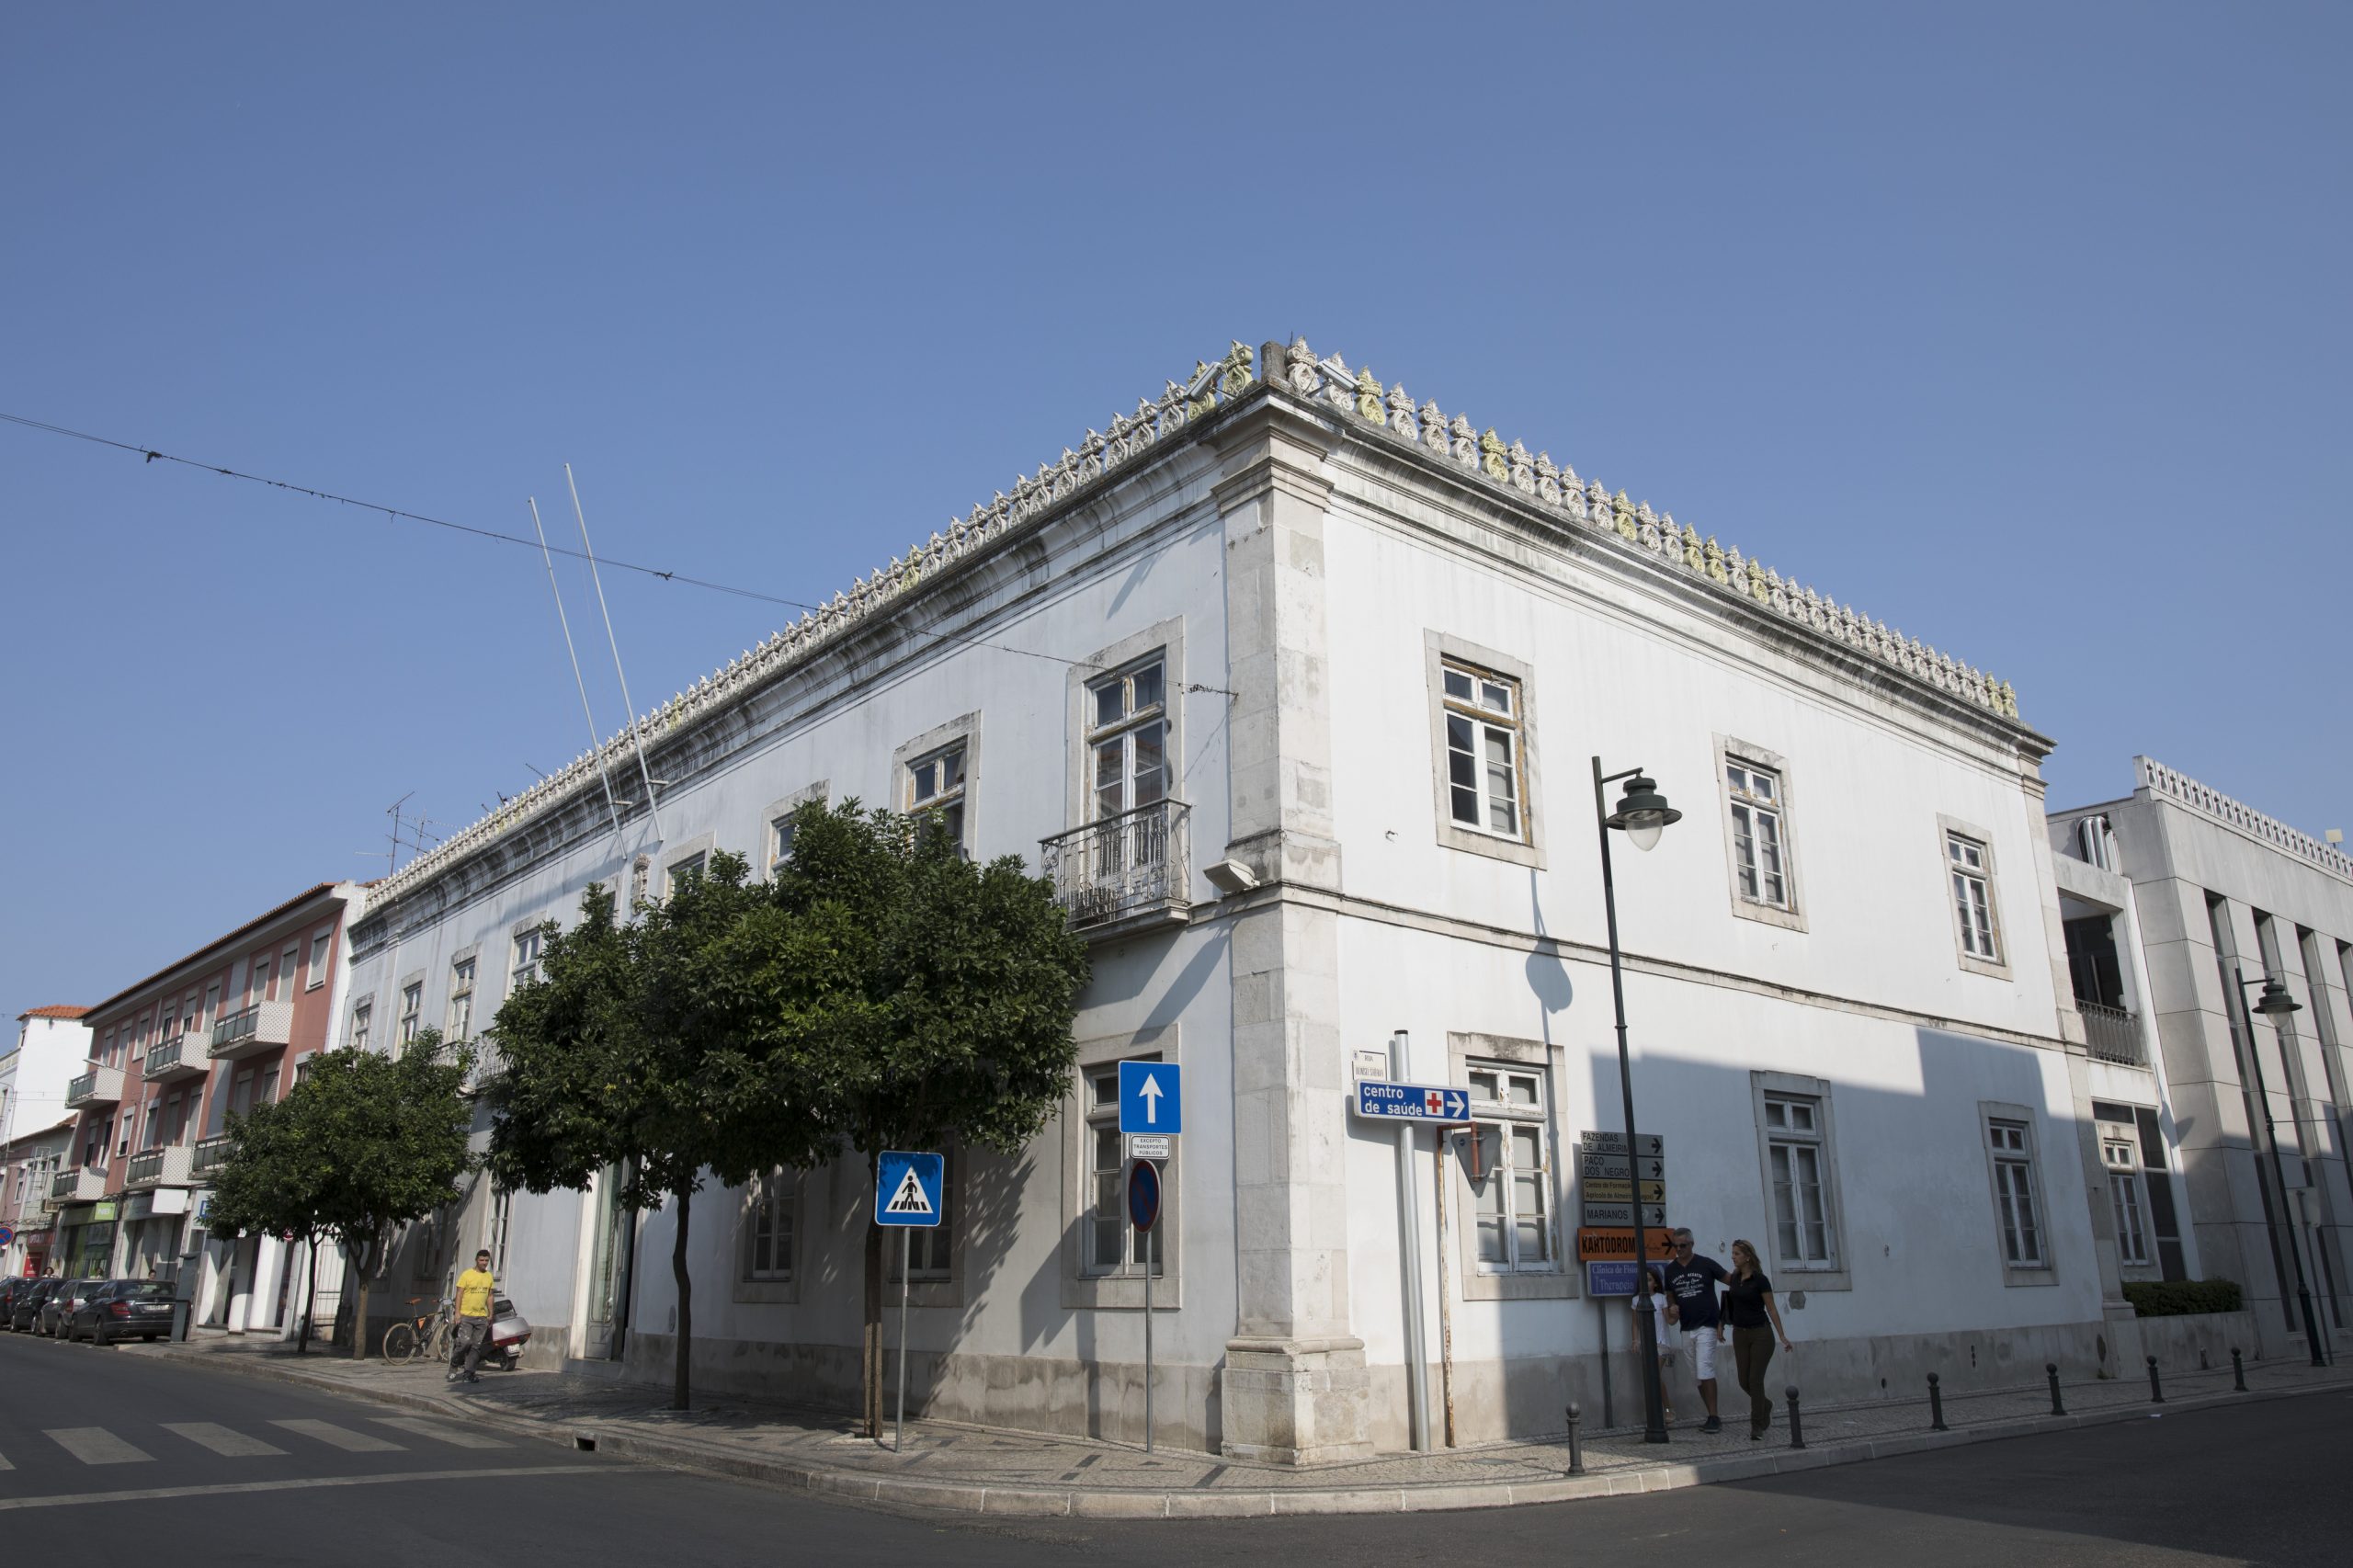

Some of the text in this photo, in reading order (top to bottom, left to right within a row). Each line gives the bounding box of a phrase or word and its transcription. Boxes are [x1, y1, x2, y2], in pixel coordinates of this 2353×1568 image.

[1364, 1054, 1374, 1062] RUA
[1364, 1085, 1404, 1099] centro
[1365, 1100, 1424, 1117] de saúde
[1582, 1131, 1619, 1142] FAZENDAS
[1583, 1142, 1593, 1152] DE
[1585, 1165, 1631, 1177] DOS NEGRO
[1586, 1209, 1629, 1221] MARIANOS
[1582, 1233, 1636, 1254] KARTÓDROM
[1592, 1264, 1614, 1274] Clínica
[1615, 1264, 1622, 1274] de
